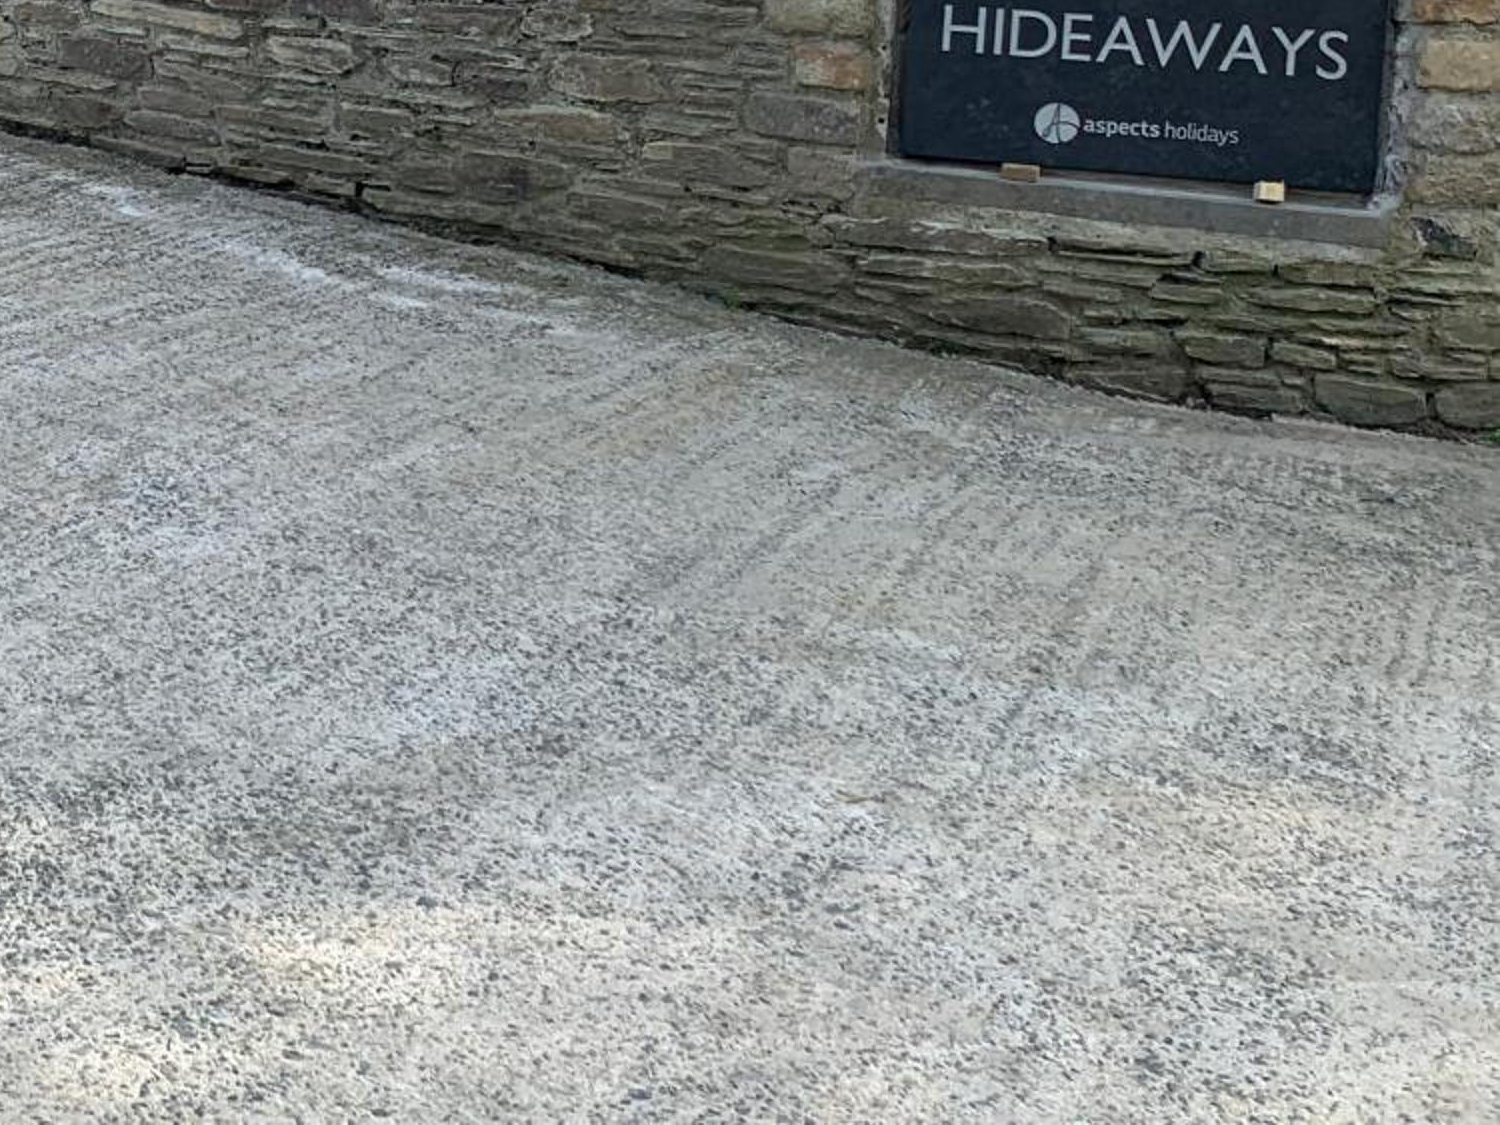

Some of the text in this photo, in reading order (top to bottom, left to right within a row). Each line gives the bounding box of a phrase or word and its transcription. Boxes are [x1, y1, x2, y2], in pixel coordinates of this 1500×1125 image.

[940, 3, 1350, 81] HIDEAWAYS
[1082, 117, 1240, 148] aspects holidays
